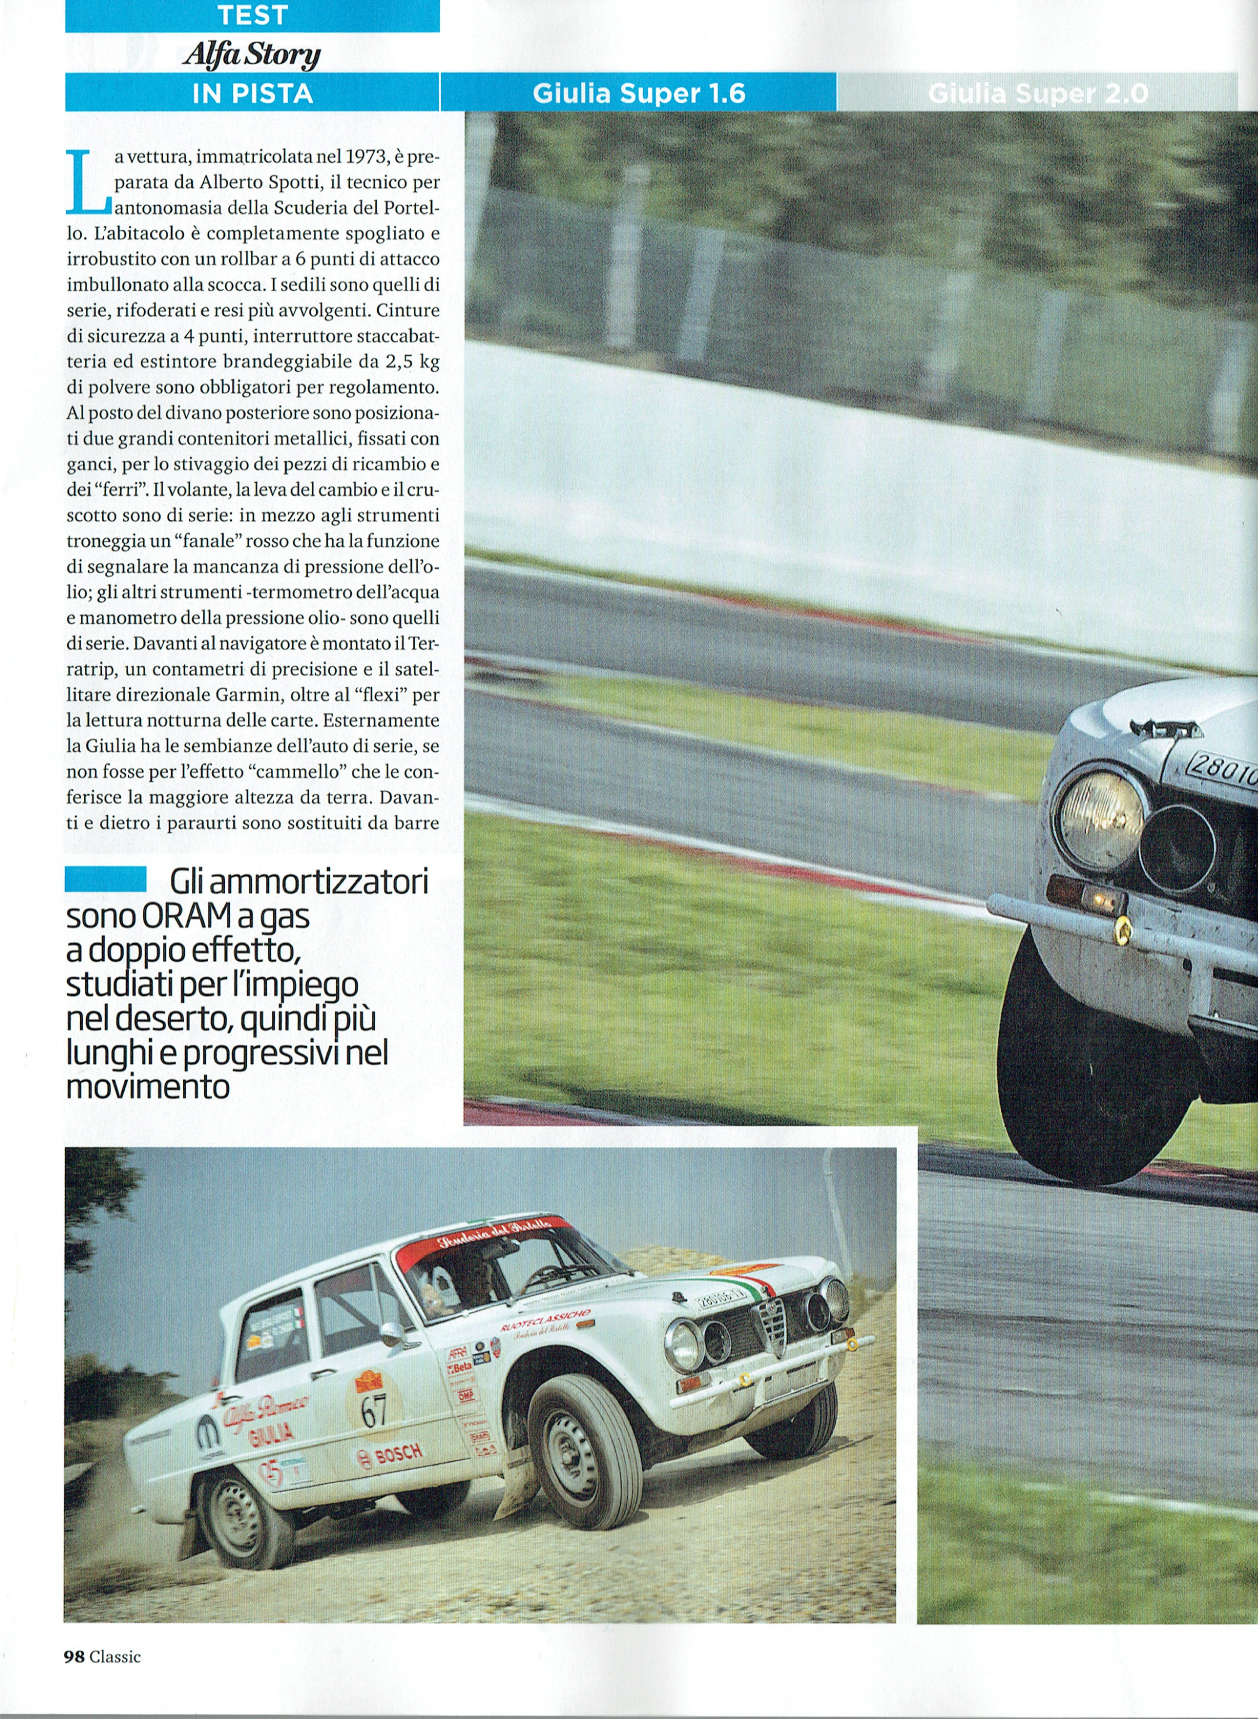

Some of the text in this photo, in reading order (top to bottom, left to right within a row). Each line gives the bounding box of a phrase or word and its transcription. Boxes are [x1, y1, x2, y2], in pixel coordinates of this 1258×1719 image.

[217, 4, 289, 26] TEST
[182, 40, 322, 73] Alfa Story
[193, 82, 314, 104] IN PISTA
[533, 81, 746, 108] Giulia Super 1.6
[928, 82, 1150, 107] Giulia Super 2.0
[114, 147, 440, 168] a vettura, immatricolata nel 1973, è pre-
[67, 276, 440, 296] imbullonato alla scocca. I sedili sono quelli di
[66, 404, 440, 424] Al posto del divano posteriore sono posiziona-
[66, 532, 440, 552] troneggia un “fanale” rosso che ha la funzione
[66, 660, 440, 681] ratrip, un contametri di precisione e il satel-
[66, 788, 439, 809] ferisce la maggiore altezza da terra. Davan-
[170, 866, 429, 895] Gli ammortizzatori
[66, 902, 311, 936] sono ORAM a gas
[66, 935, 302, 970] a doppio effetto,
[66, 969, 360, 1004] studiati per l'impiego
[67, 1003, 377, 1038] nel deserto, quindi più
[67, 1038, 389, 1072] lunghi e progressivi nel
[66, 1072, 231, 1100] movimento
[436, 1231, 491, 1249] Scuderia
[500, 1309, 591, 1332] RUOTECLASSICHE
[454, 1361, 472, 1374] Beta
[361, 1393, 387, 1429] 67
[248, 1421, 296, 1449] GIULIA
[374, 1442, 424, 1465] BOSCH
[63, 1649, 141, 1664] 98 Classic
